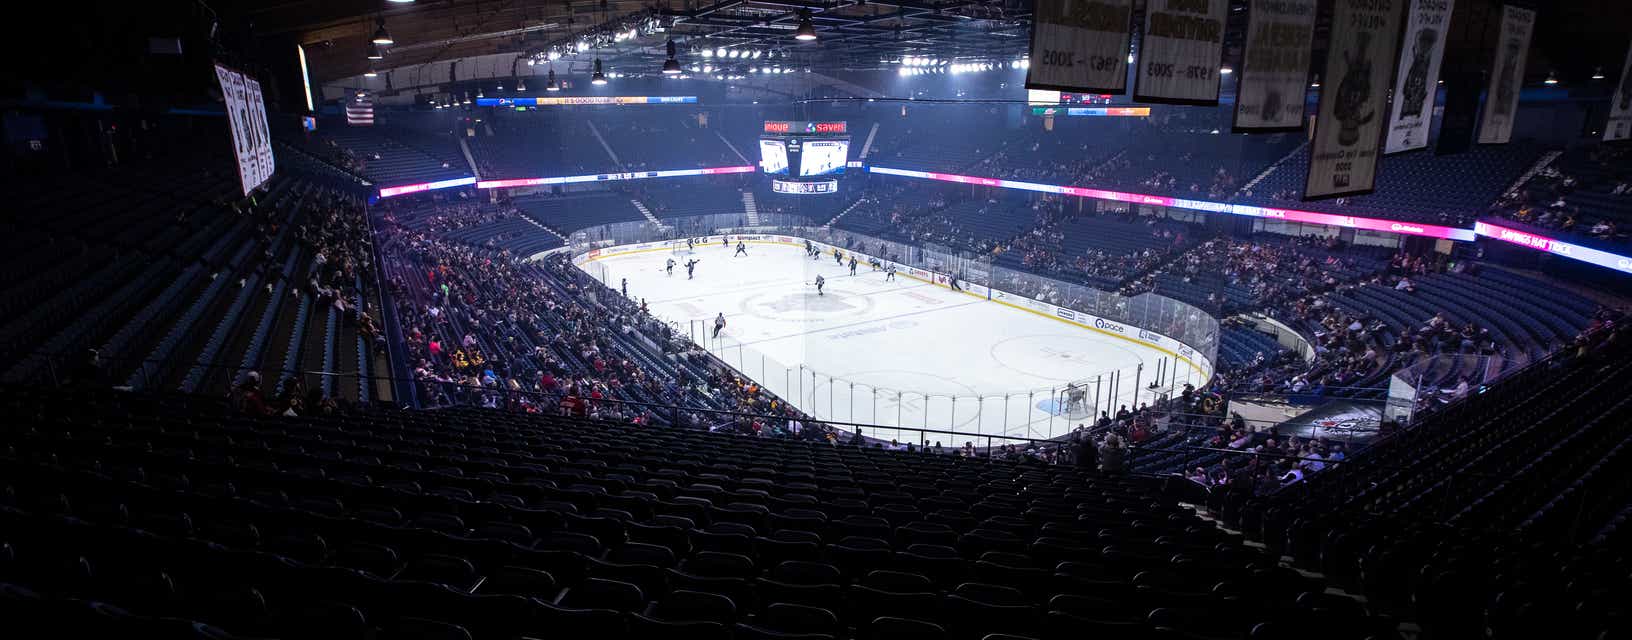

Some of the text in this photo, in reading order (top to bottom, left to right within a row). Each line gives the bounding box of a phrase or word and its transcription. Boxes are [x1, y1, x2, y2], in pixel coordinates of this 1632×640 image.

[1501, 229, 1571, 254] SAVINGS HAT TRICK
[1104, 322, 1124, 333] pace
